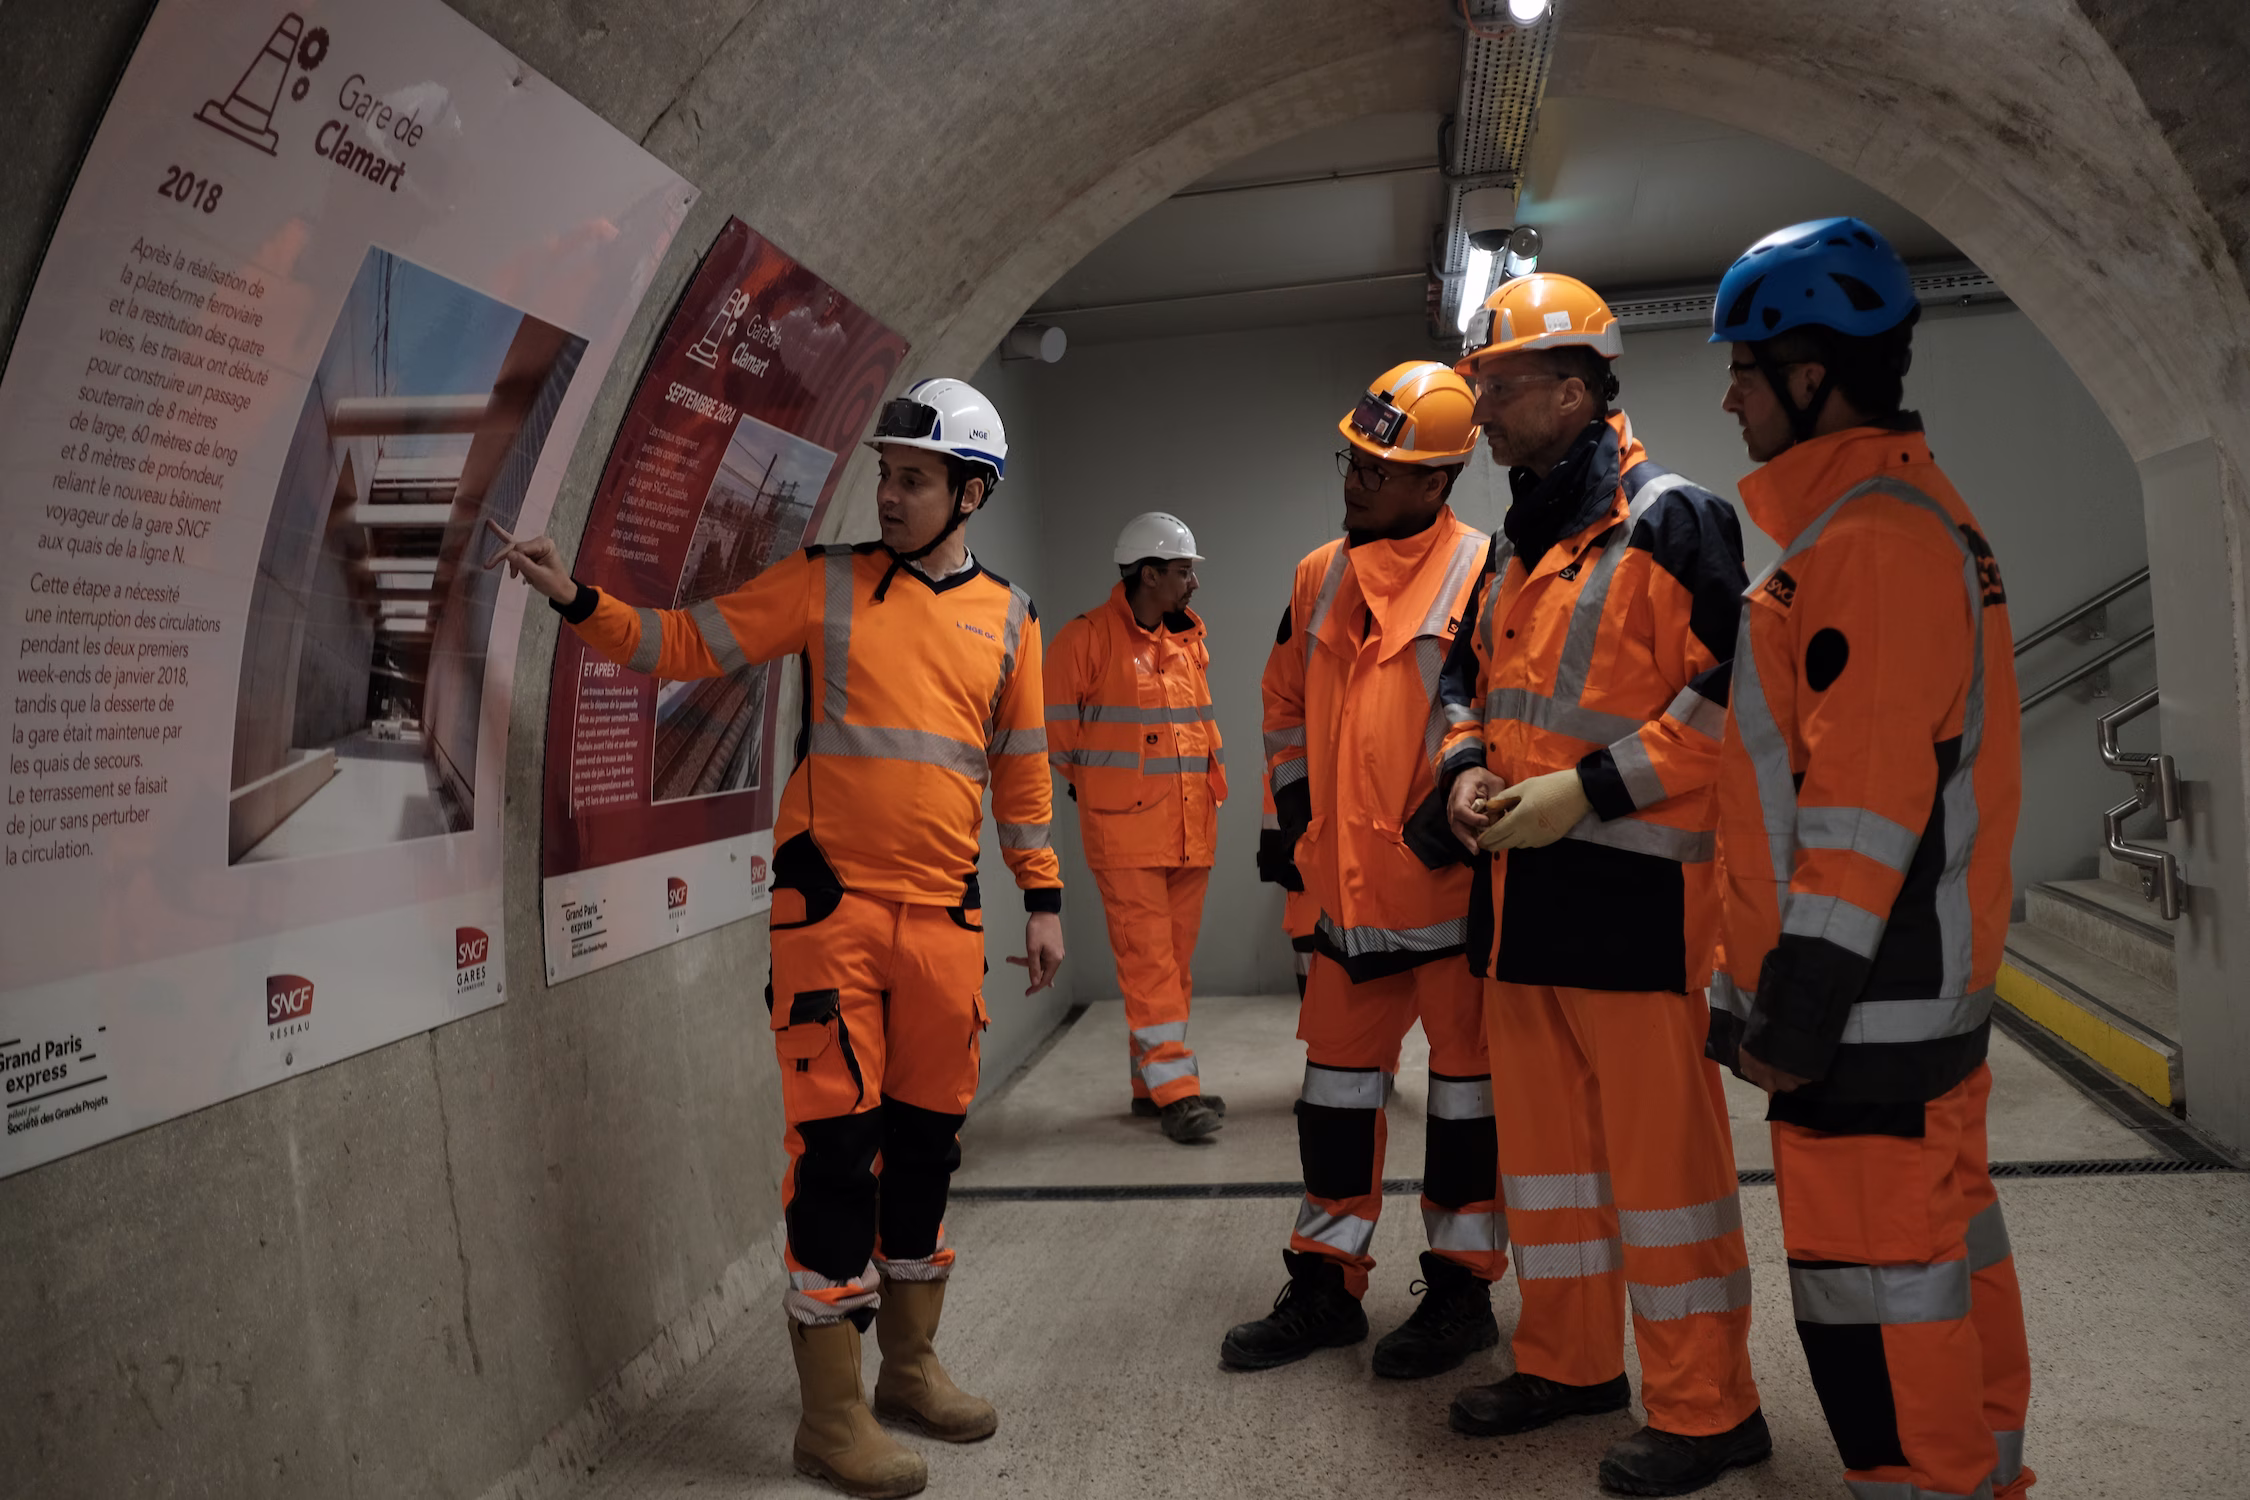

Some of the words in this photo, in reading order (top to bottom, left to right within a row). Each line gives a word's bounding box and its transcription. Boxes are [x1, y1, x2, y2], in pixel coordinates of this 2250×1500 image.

[338, 74, 392, 129] Gare
[394, 108, 423, 148] de
[314, 119, 406, 192] Clamart
[157, 164, 223, 214] 2018
[130, 235, 172, 266] Après
[173, 249, 185, 271] la
[187, 258, 247, 292] réalisation
[249, 278, 265, 299] de
[120, 263, 133, 286] la
[132, 271, 205, 309] plateforme
[206, 292, 263, 328] ferroviaire
[109, 299, 124, 315] et
[126, 297, 139, 320] la
[140, 308, 203, 338] restitution
[205, 324, 227, 347] des
[228, 335, 265, 357] quatre
[747, 314, 769, 344] Gare
[767, 326, 782, 350] de
[99, 327, 135, 353] voies,
[140, 333, 158, 357] les
[161, 344, 205, 368] travaux
[206, 358, 228, 375] ont
[228, 361, 269, 387] débuté
[732, 342, 770, 378] Clamart
[85, 356, 122, 377] pour
[123, 365, 185, 392] construire
[187, 382, 202, 397] un
[202, 388, 251, 412] passage
[78, 385, 144, 412] souterrain
[147, 397, 164, 418] de
[167, 402, 176, 420] 8
[177, 407, 218, 429] mètres
[665, 381, 718, 418] SEPTEMBRE
[714, 402, 737, 425] 2024
[69, 410, 88, 431] de
[91, 414, 127, 443] large,
[132, 424, 150, 444] 60
[150, 431, 192, 453] mètres
[194, 437, 210, 456] de
[212, 441, 238, 467] long
[973, 430, 988, 440] NGE
[61, 445, 76, 460] et
[78, 443, 89, 461] 8
[91, 449, 136, 472] mètres
[138, 455, 155, 475] de
[156, 461, 224, 489] profondeur,
[52, 470, 96, 494] reliant
[98, 476, 110, 496] le
[113, 485, 167, 505] nouveau
[169, 488, 221, 514] bâtiment
[46, 504, 109, 528] voyageur
[112, 508, 129, 528] de
[132, 511, 142, 531] la
[144, 520, 173, 537] gare
[175, 518, 211, 538] SNCF
[38, 533, 64, 550] aux
[67, 535, 102, 559] quais
[106, 537, 123, 557] de
[126, 539, 136, 558] la
[140, 540, 170, 565] ligne
[173, 545, 185, 563] N.
[30, 572, 69, 595] Cette
[72, 576, 110, 603] étape
[114, 586, 121, 598] a
[125, 582, 180, 603] nécessité
[25, 607, 51, 624] une
[56, 605, 131, 632] interruption
[134, 609, 156, 630] des
[159, 612, 221, 633] circulations
[965, 624, 983, 636] NGE
[985, 632, 996, 641] GC
[20, 633, 79, 659] pendant
[83, 635, 101, 655] les
[104, 636, 135, 656] deux
[138, 639, 189, 662] premiers
[18, 663, 91, 684] week-ends
[95, 665, 111, 684] de
[114, 666, 155, 689] janvier
[158, 666, 188, 688] 2018,
[584, 662, 593, 677] ET
[593, 660, 615, 677] APRÈS
[616, 664, 620, 677] ?
[15, 693, 57, 714] tandis
[61, 698, 86, 719] que
[90, 693, 100, 713] la
[105, 693, 155, 713] desserte
[159, 693, 174, 711] de
[12, 723, 23, 744] la
[28, 728, 59, 749] gare
[63, 723, 92, 742] était
[96, 722, 160, 741] maintenue
[162, 725, 182, 746] par
[10, 753, 29, 774] les
[33, 752, 69, 780] quais
[73, 750, 90, 771] de
[94, 754, 143, 770] secours.
[9, 785, 24, 805] Le
[29, 780, 114, 803] terrassement
[118, 782, 131, 796] se
[135, 776, 168, 795] faisait
[6, 814, 25, 836] de
[28, 814, 56, 839] jour
[60, 813, 88, 831] sans
[92, 804, 150, 833] perturber
[6, 845, 17, 866] la
[22, 840, 93, 864] circulation.
[752, 864, 765, 880] SNCF
[669, 886, 686, 906] SNCF
[566, 905, 583, 922] Grand
[584, 902, 597, 916] Paris
[570, 920, 592, 934] express
[458, 937, 486, 964] SNCF
[457, 966, 486, 986] GARES
[270, 986, 311, 1019] SNCF
[270, 1021, 310, 1040] RÉSEAU
[45, 1033, 82, 1060] Paris
[6, 1063, 67, 1093] express
[8, 1116, 38, 1135] Société
[41, 1113, 54, 1124] des
[55, 1102, 82, 1119] Grands
[83, 1095, 108, 1111] Projets
